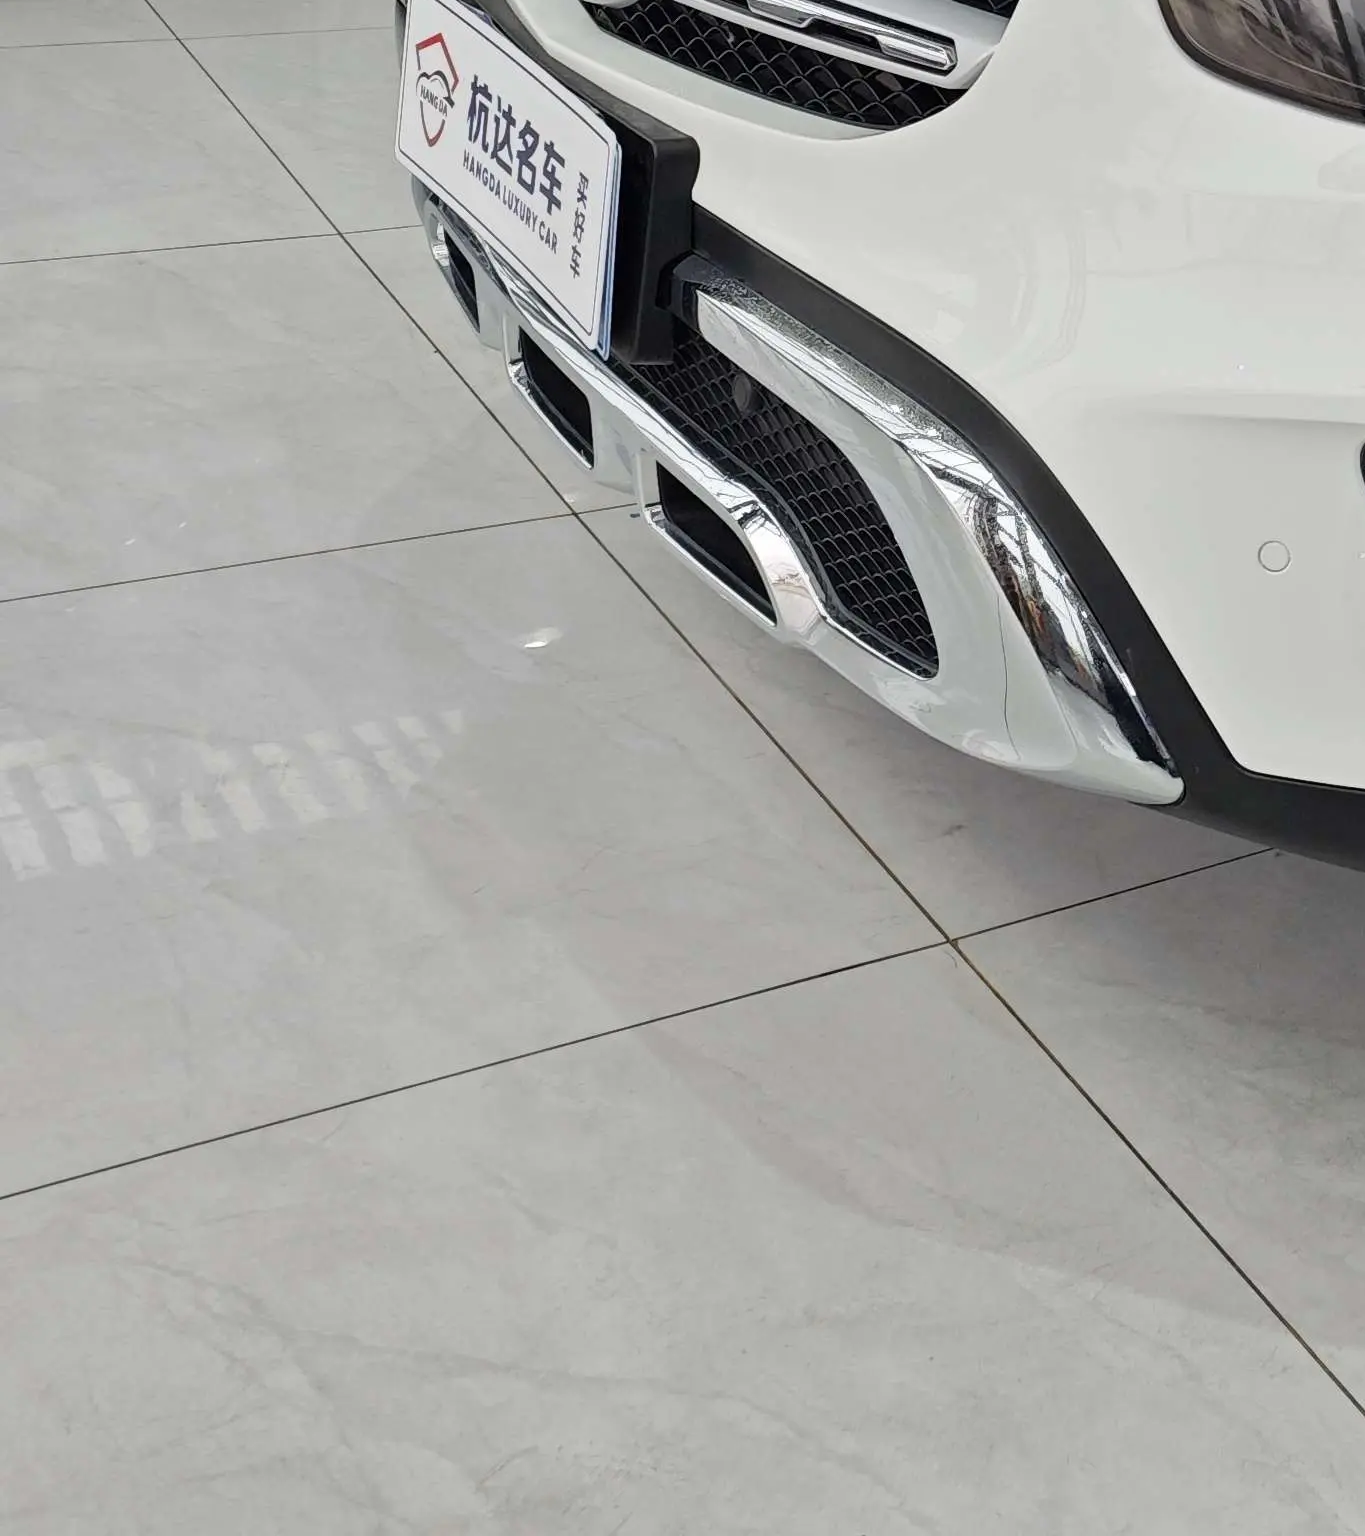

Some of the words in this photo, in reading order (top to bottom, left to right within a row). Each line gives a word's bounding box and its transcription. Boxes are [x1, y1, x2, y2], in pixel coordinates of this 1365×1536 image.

[463, 149, 501, 200] HANGDA
[502, 184, 538, 233] LUXURY
[538, 221, 558, 255] CAR
[467, 74, 565, 215] 杭达名车
